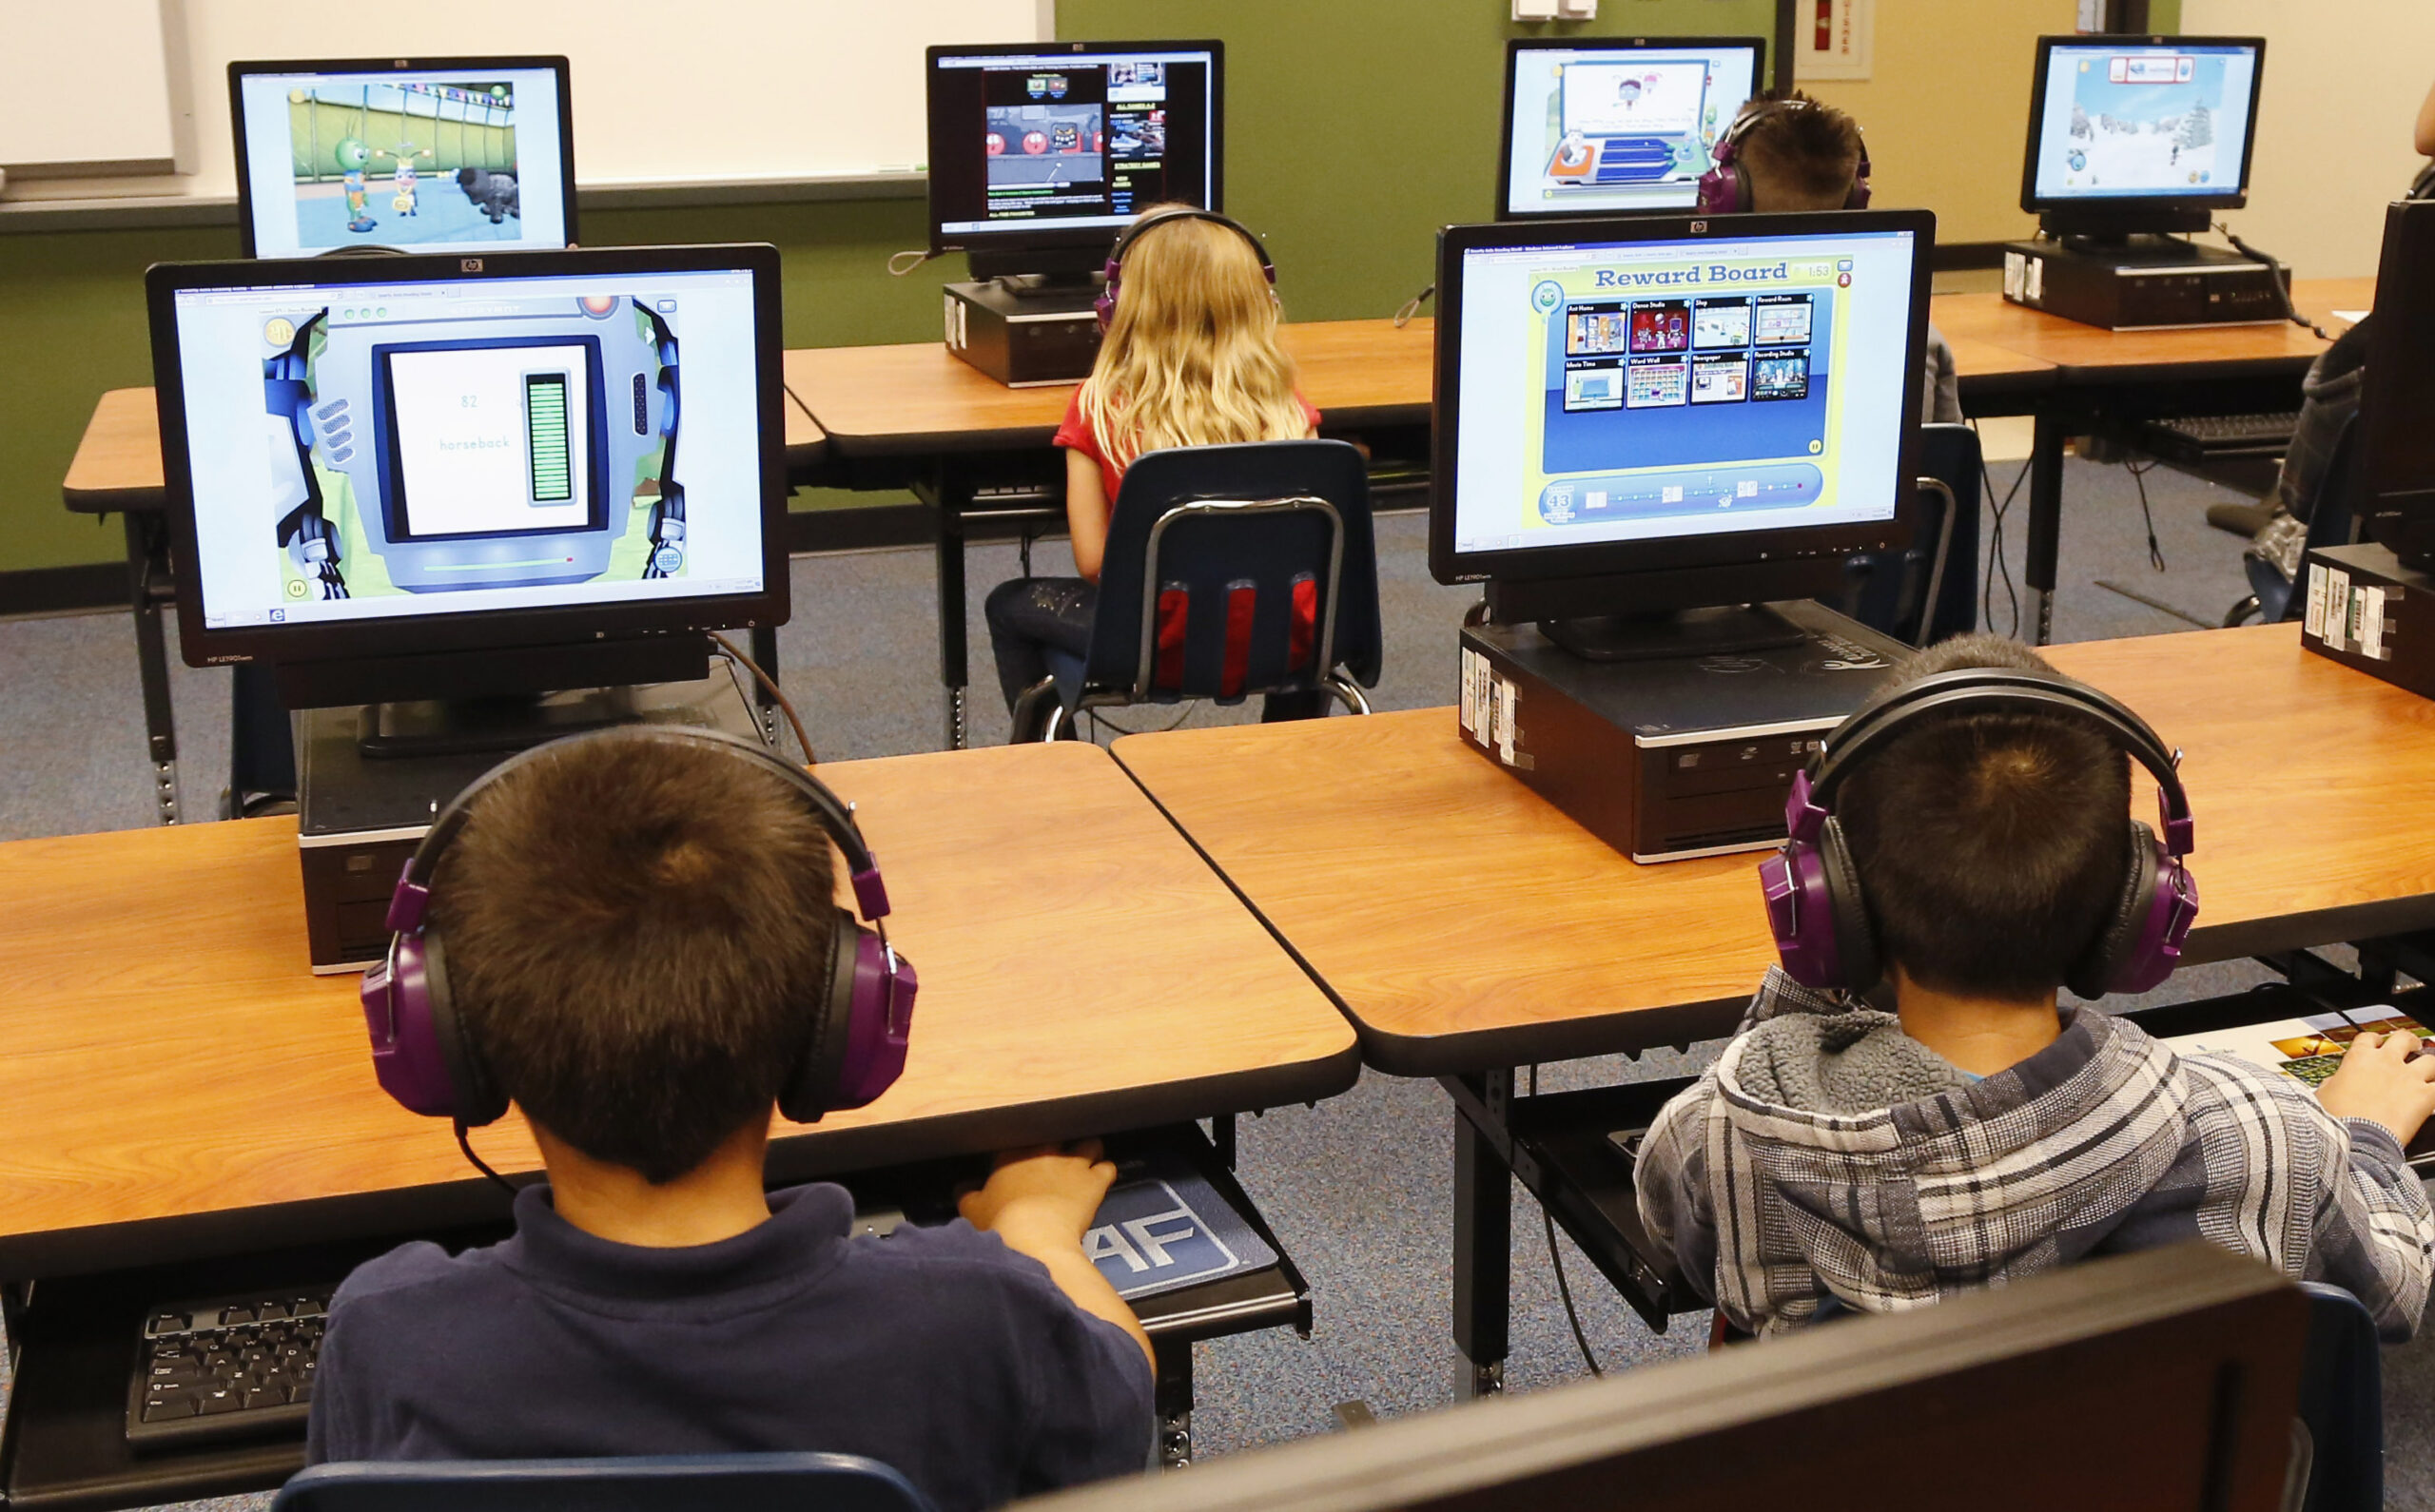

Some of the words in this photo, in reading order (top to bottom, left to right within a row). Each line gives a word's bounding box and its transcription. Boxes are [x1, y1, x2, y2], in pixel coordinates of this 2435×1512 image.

[1595, 265, 1701, 287] Reward
[1707, 262, 1788, 281] Board
[1808, 265, 1829, 278] 1:53
[460, 395, 477, 408] 82
[439, 435, 510, 451] horseback
[1549, 494, 1569, 507] 43
